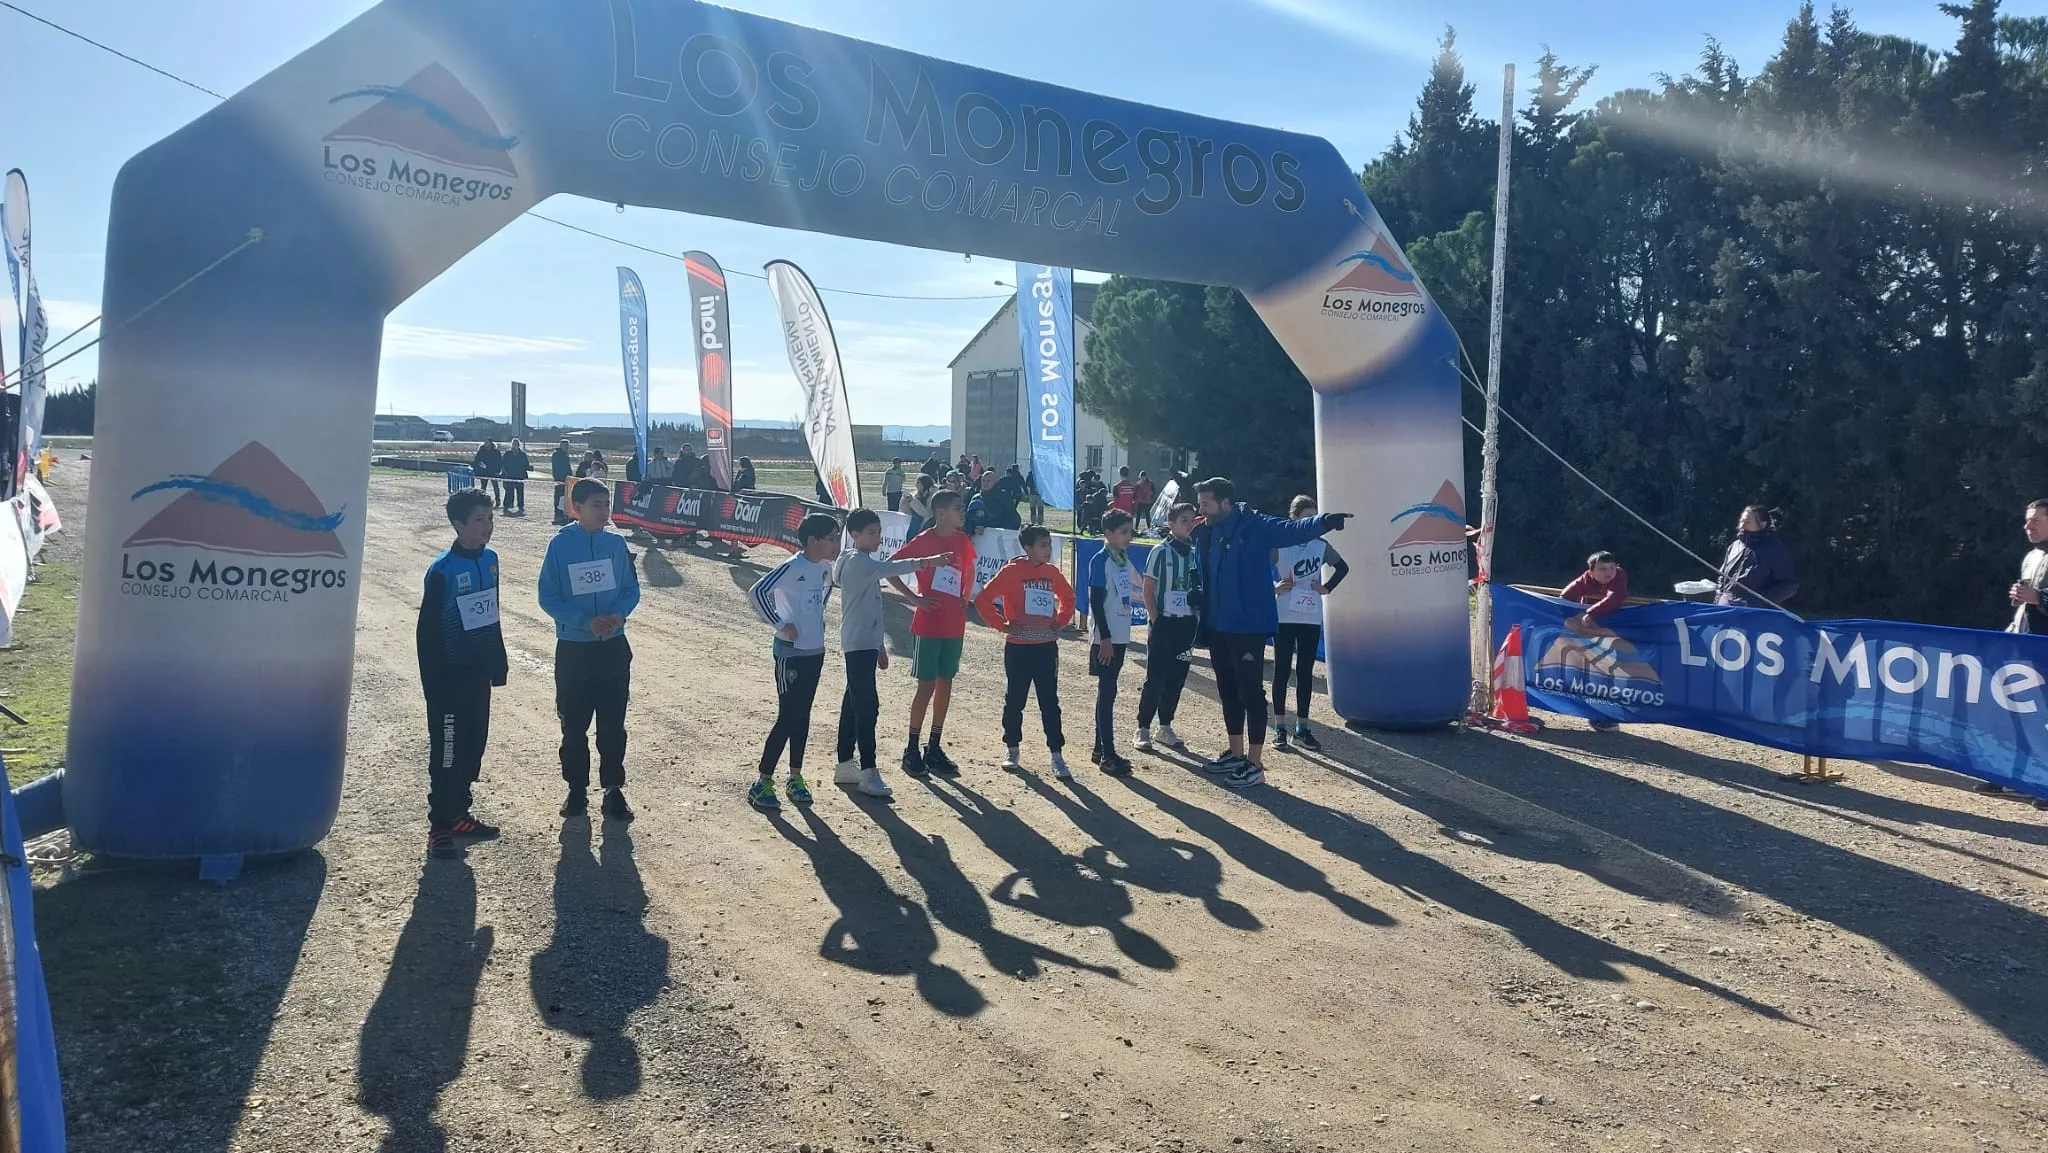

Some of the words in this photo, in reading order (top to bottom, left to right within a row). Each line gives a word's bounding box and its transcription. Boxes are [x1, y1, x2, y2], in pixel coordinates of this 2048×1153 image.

[609, 0, 820, 131] Los
[863, 53, 1306, 216] Monegros
[323, 145, 377, 176] Los
[387, 157, 513, 201] Monegros
[607, 113, 867, 197] CONSEJO
[884, 164, 1123, 237] COMARCAL
[323, 170, 391, 193] CONSEJO
[395, 184, 460, 207] COMARCAL
[1320, 309, 1359, 320] CONSEJO
[1323, 294, 1353, 311] Los
[1358, 297, 1426, 317] Monegros
[1390, 552, 1422, 567] Los
[121, 553, 175, 582] Los
[188, 559, 347, 594] Monegros
[584, 570, 602, 584] 38
[1391, 566, 1431, 576] CONSEJO
[120, 582, 192, 599] CONSEJO
[197, 587, 289, 602] COMARCAL
[1036, 596, 1048, 607] 35
[1175, 597, 1186, 607] 21
[474, 599, 490, 615] 37
[1673, 617, 1785, 677] Los
[1535, 672, 1564, 691] Los
[1570, 676, 1665, 706] Monegros
